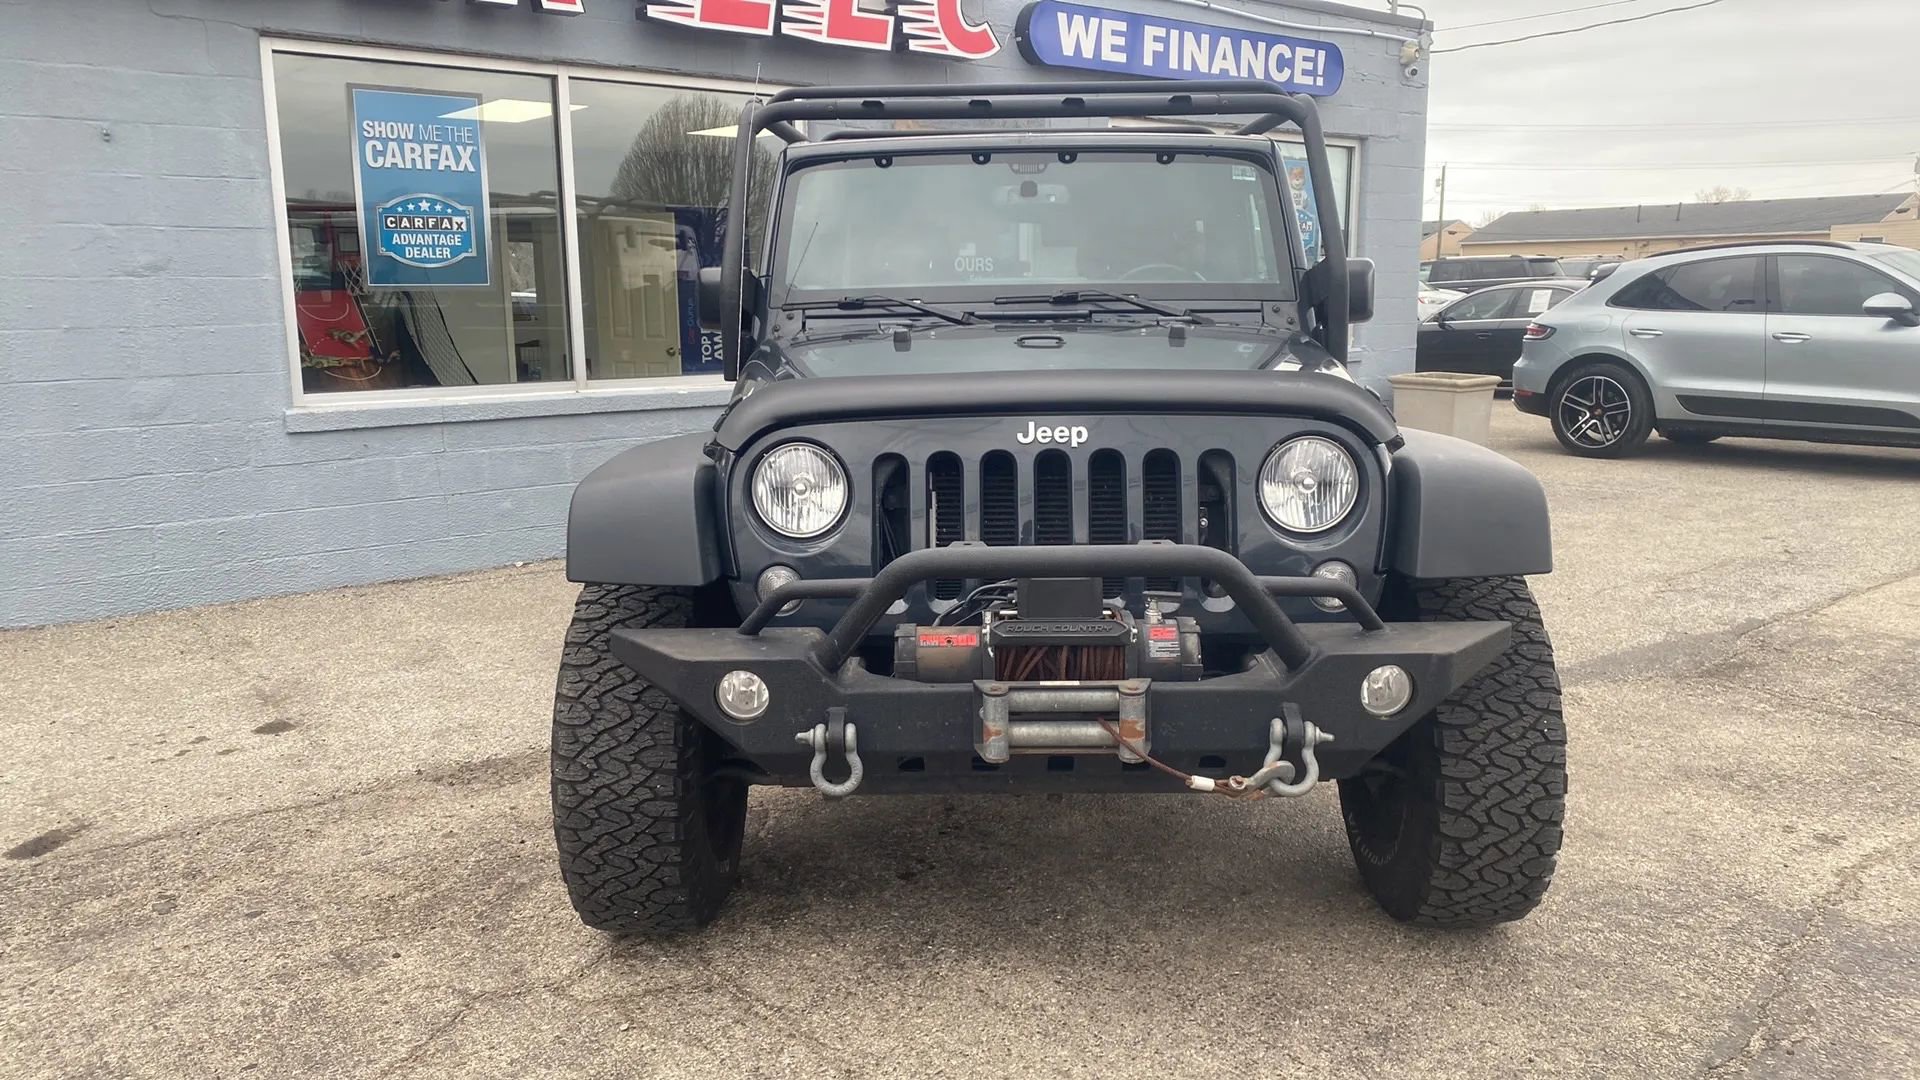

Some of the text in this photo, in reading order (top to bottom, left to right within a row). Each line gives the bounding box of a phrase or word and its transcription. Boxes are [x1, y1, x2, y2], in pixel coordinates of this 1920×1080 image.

[1057, 12, 1326, 87] WE FINANCE!
[363, 120, 474, 144] SHOW ME THE
[365, 140, 476, 172] CARFAX
[386, 216, 466, 232] CARFAX
[392, 233, 462, 246] ADVANTAGE
[405, 246, 451, 259] DEALER
[954, 256, 994, 272] OURS
[702, 336, 711, 363] TOP
[1016, 421, 1088, 448] Jeep
[1006, 623, 1113, 633] ROUGH COUNTRY
